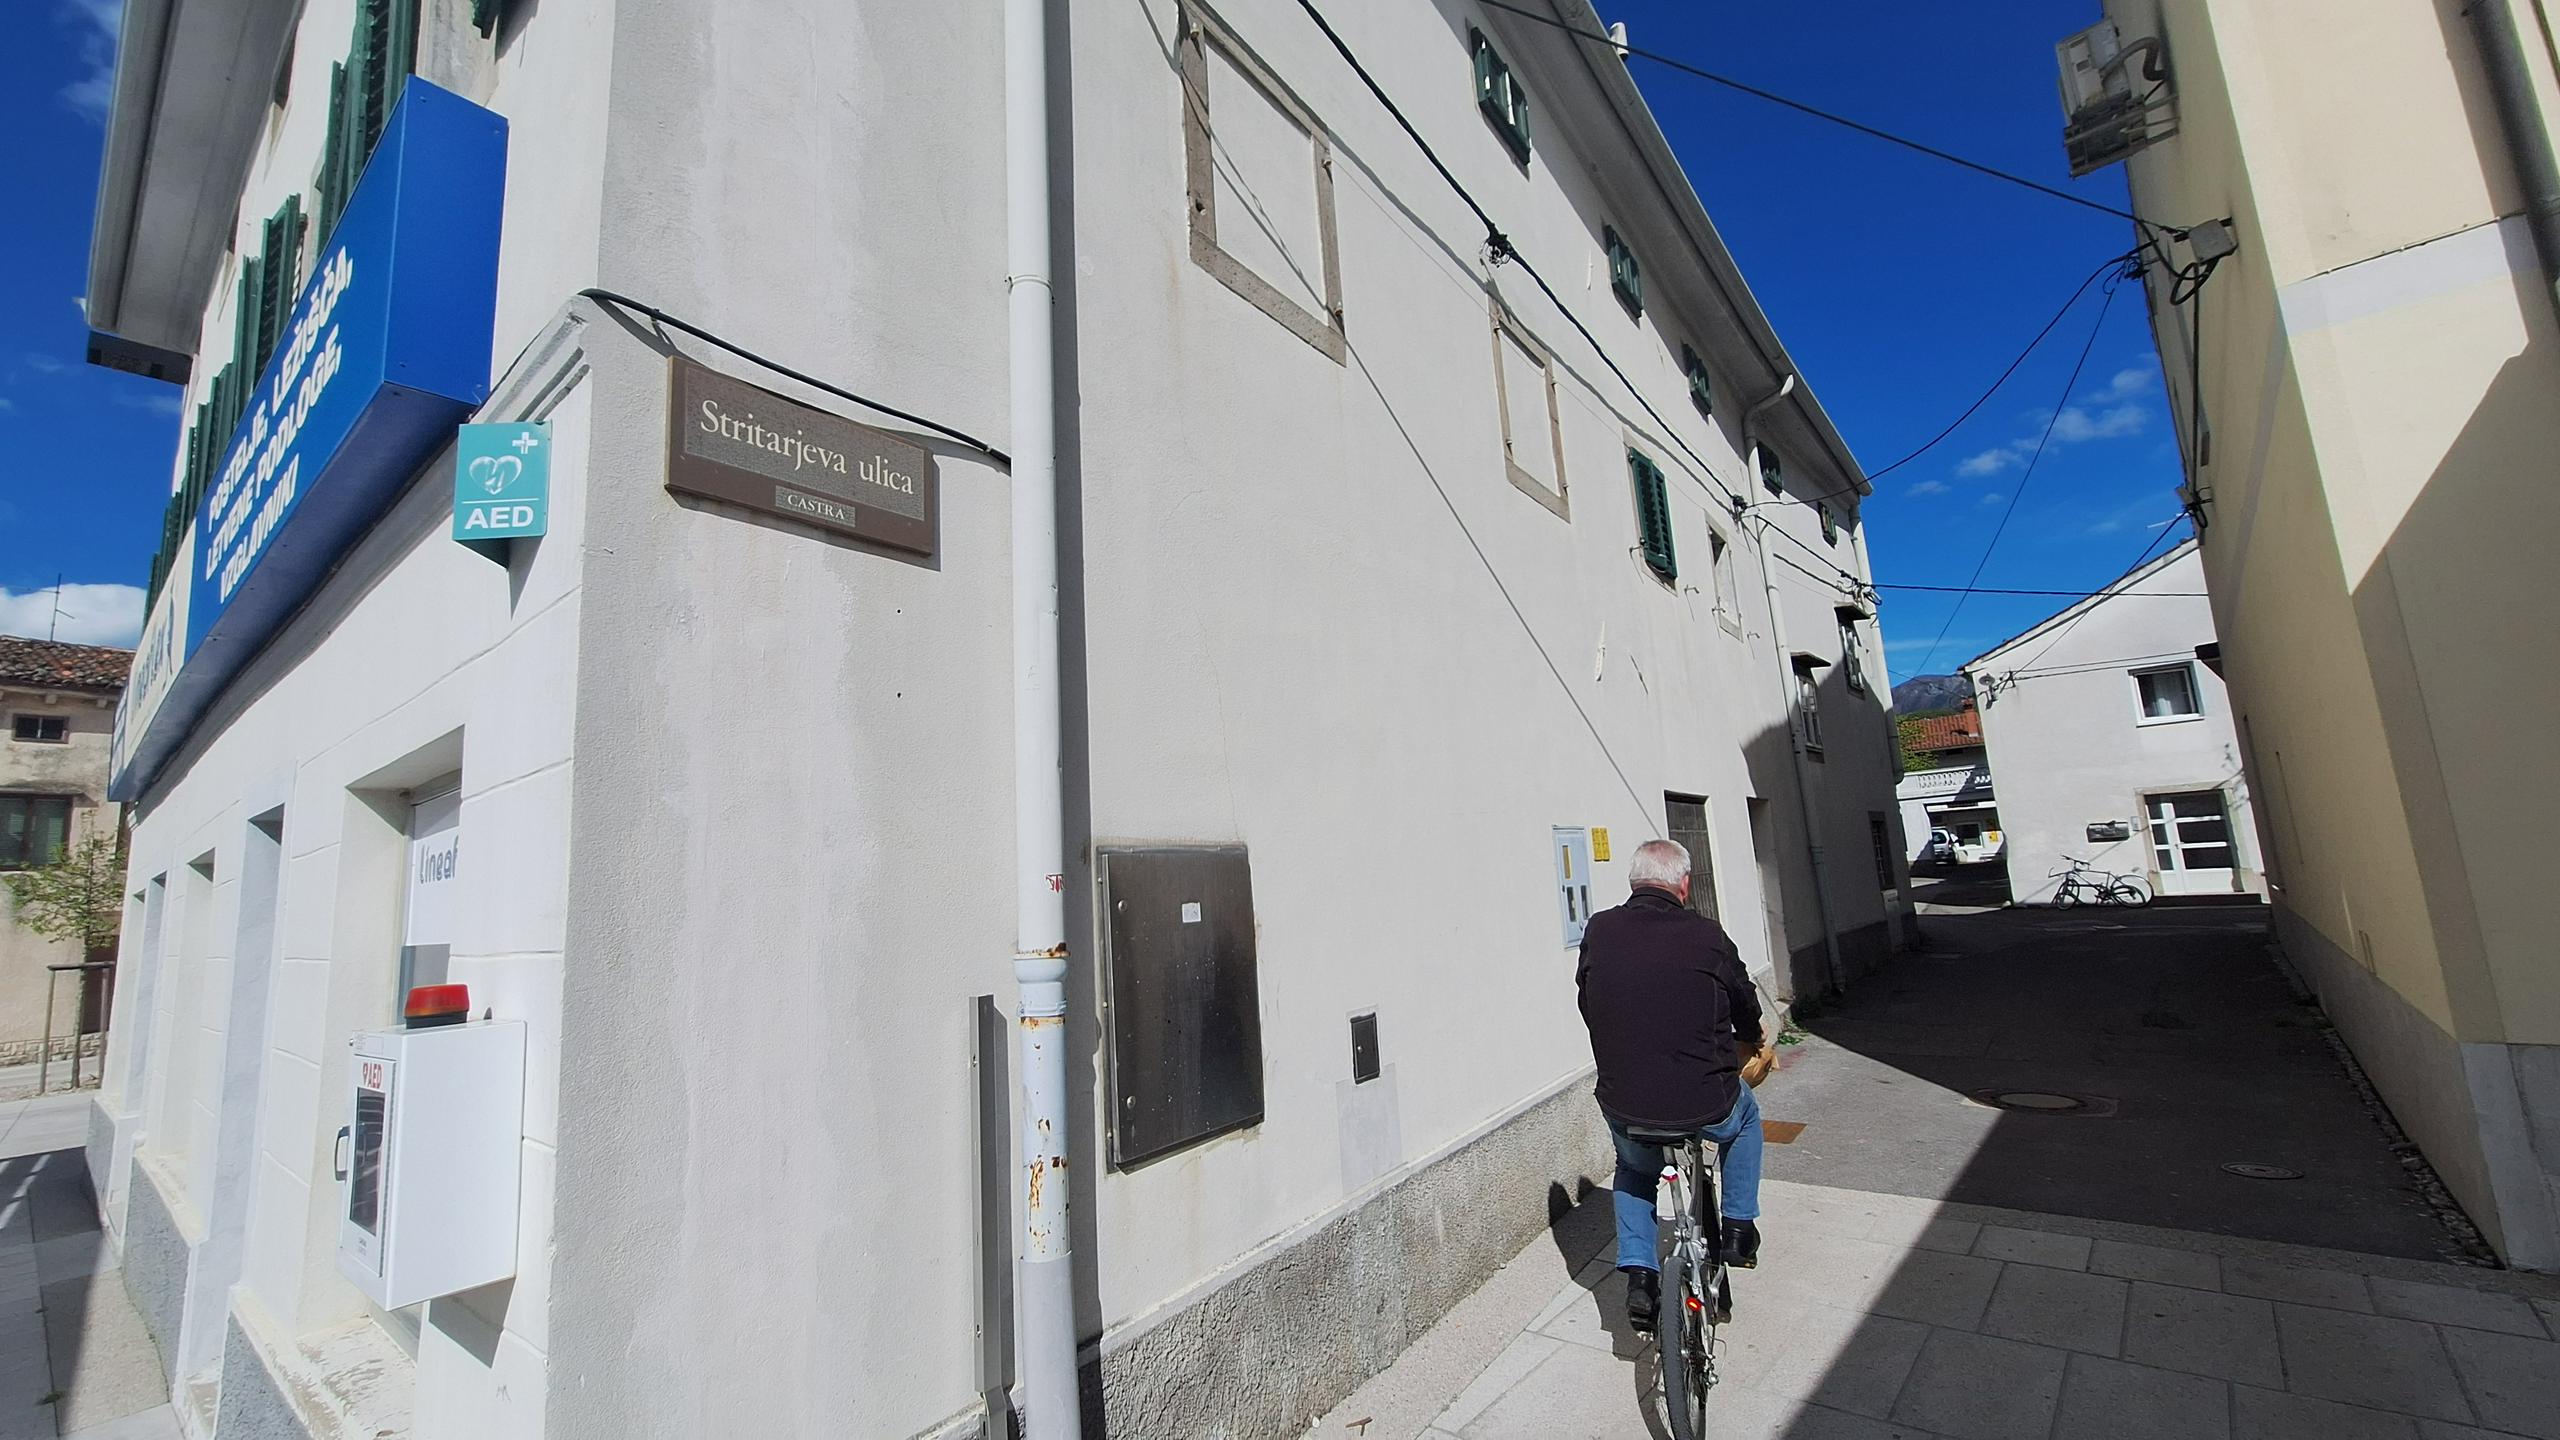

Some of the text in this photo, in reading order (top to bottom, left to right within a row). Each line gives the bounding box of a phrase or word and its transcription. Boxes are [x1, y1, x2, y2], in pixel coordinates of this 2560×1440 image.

[209, 245, 353, 533] POSTELJE, LEŽIŠČA,
[206, 323, 345, 581] LETVENE PODLOGE,
[701, 399, 914, 494] Stritarjeva ulica
[220, 453, 299, 604] VZGLAVNIKI
[464, 506, 534, 529] AED
[787, 494, 845, 520] CASTRA
[367, 1062, 382, 1089] AED
